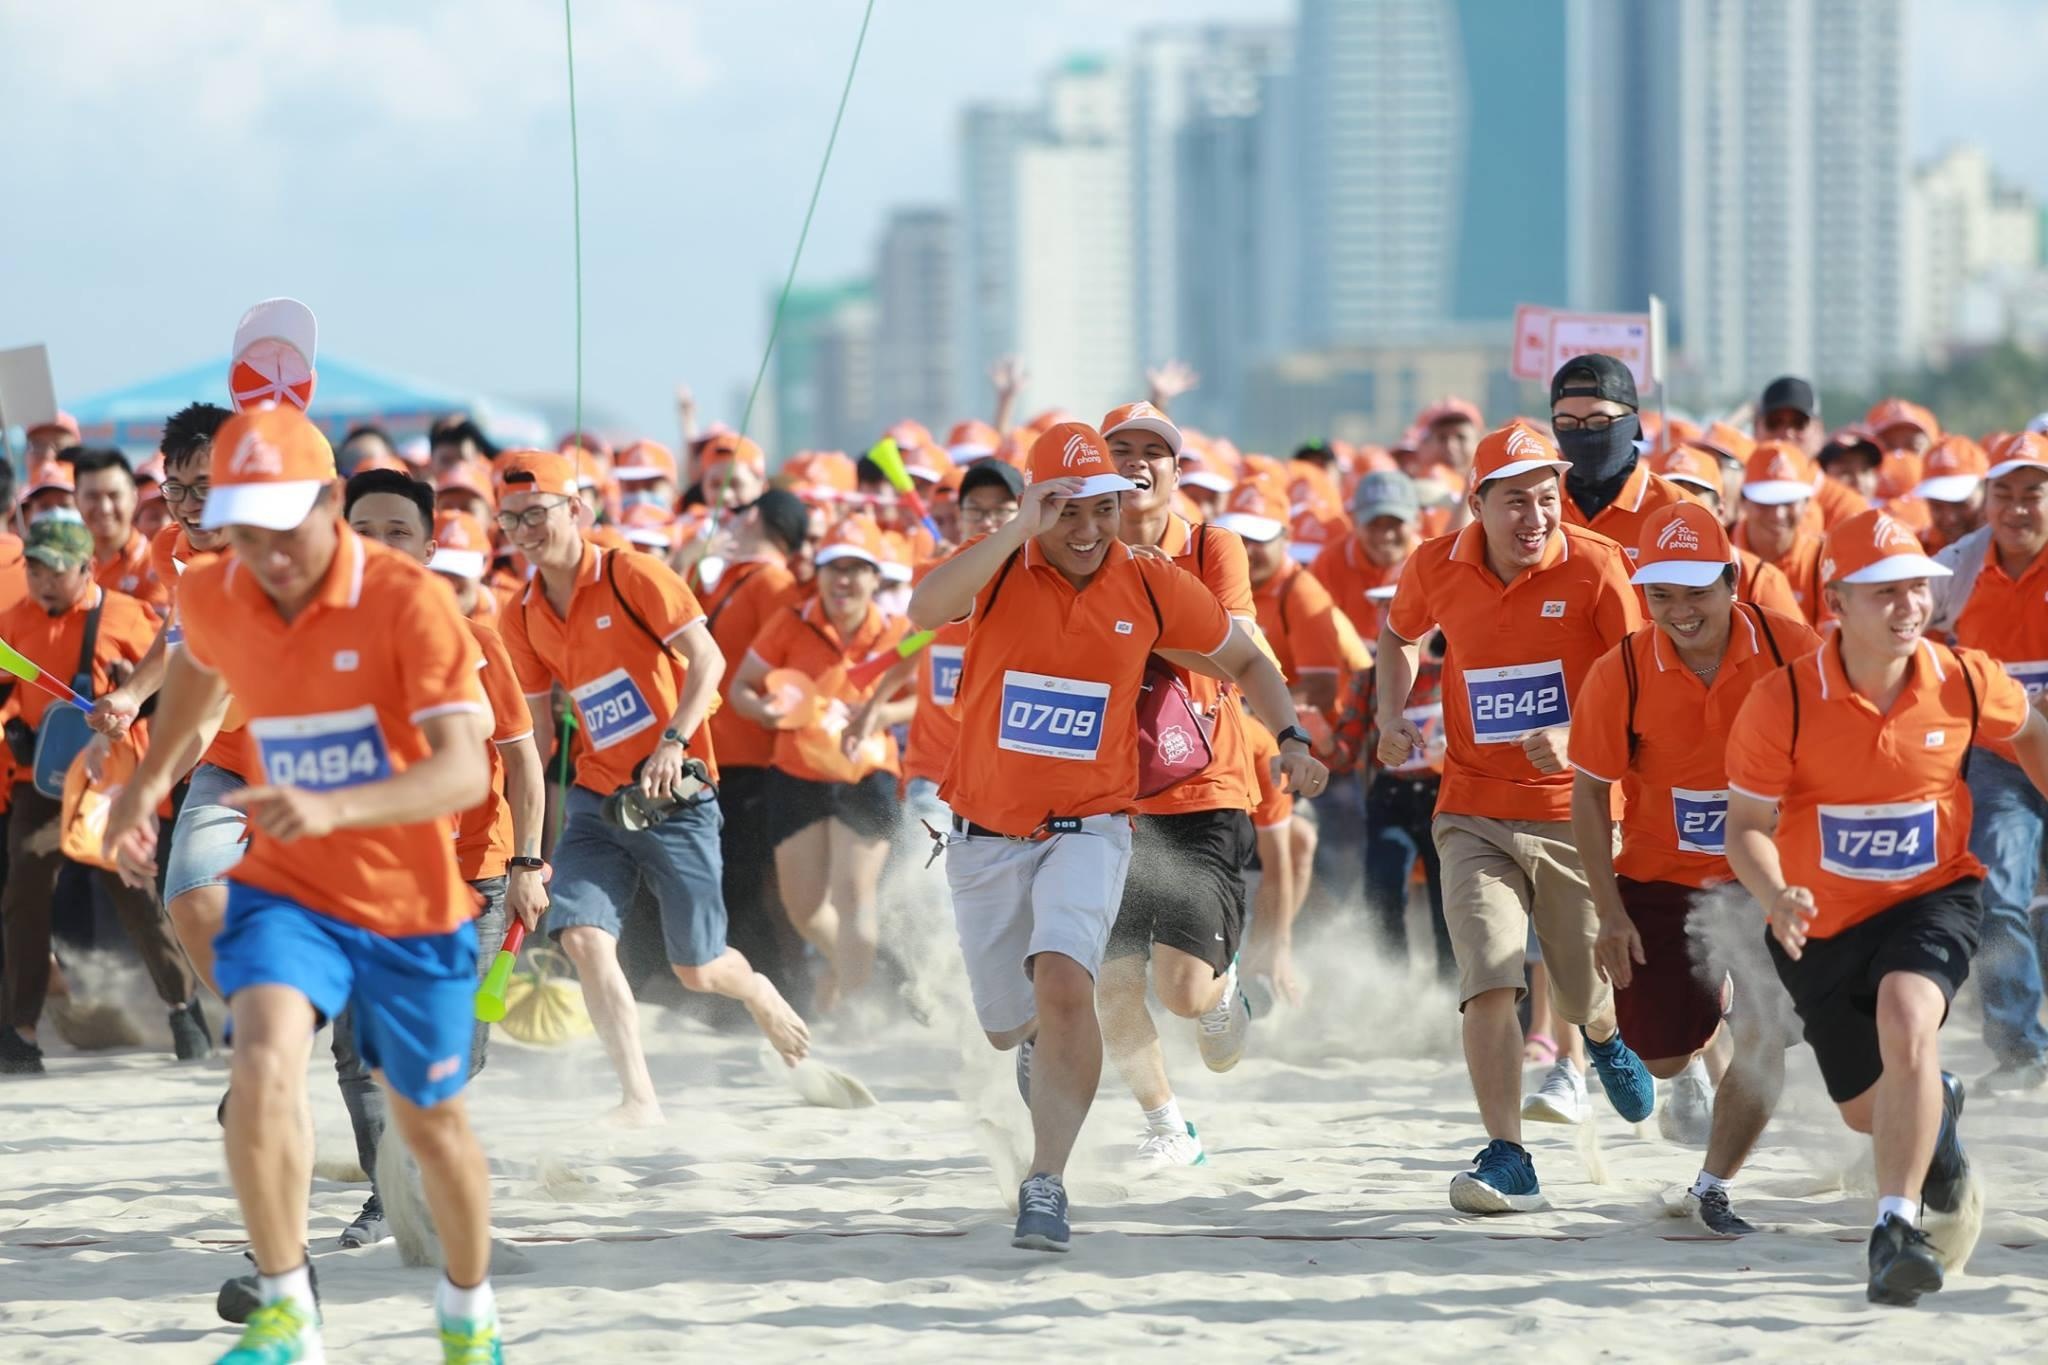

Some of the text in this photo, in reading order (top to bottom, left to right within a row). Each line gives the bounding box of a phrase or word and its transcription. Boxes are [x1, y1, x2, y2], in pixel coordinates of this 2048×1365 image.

[1669, 541, 1698, 552] phong
[584, 690, 637, 733] 0730
[1007, 700, 1097, 737] 0709
[1476, 686, 1559, 721] 2642
[270, 739, 379, 786] 0494
[1683, 810, 1728, 833] 27
[1837, 826, 1920, 857] 1794
